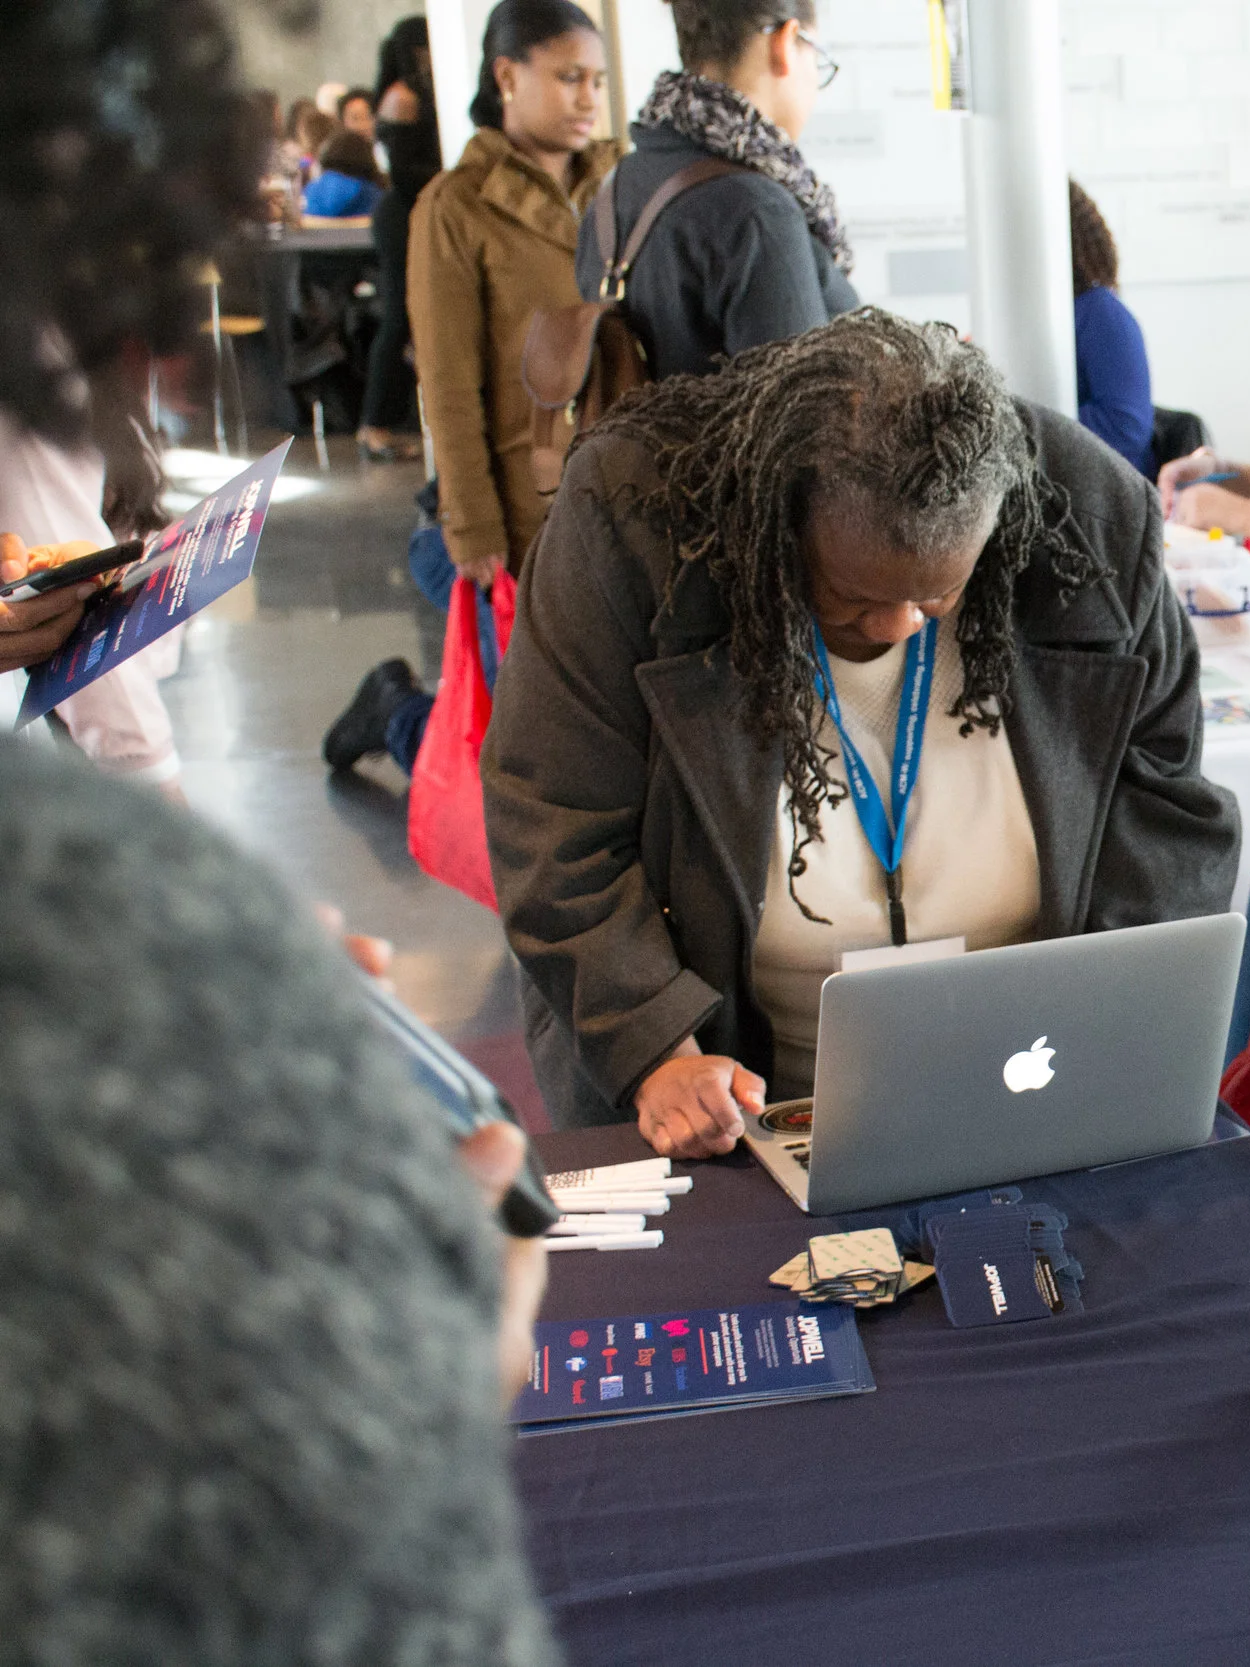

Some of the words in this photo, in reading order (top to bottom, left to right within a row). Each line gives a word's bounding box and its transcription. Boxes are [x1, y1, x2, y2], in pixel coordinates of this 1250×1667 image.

[983, 1263, 1008, 1315] JOPWELL
[634, 1348, 656, 1366] Etsy
[789, 1337, 803, 1365] Opportunity
[797, 1315, 825, 1364] JOPWELL
